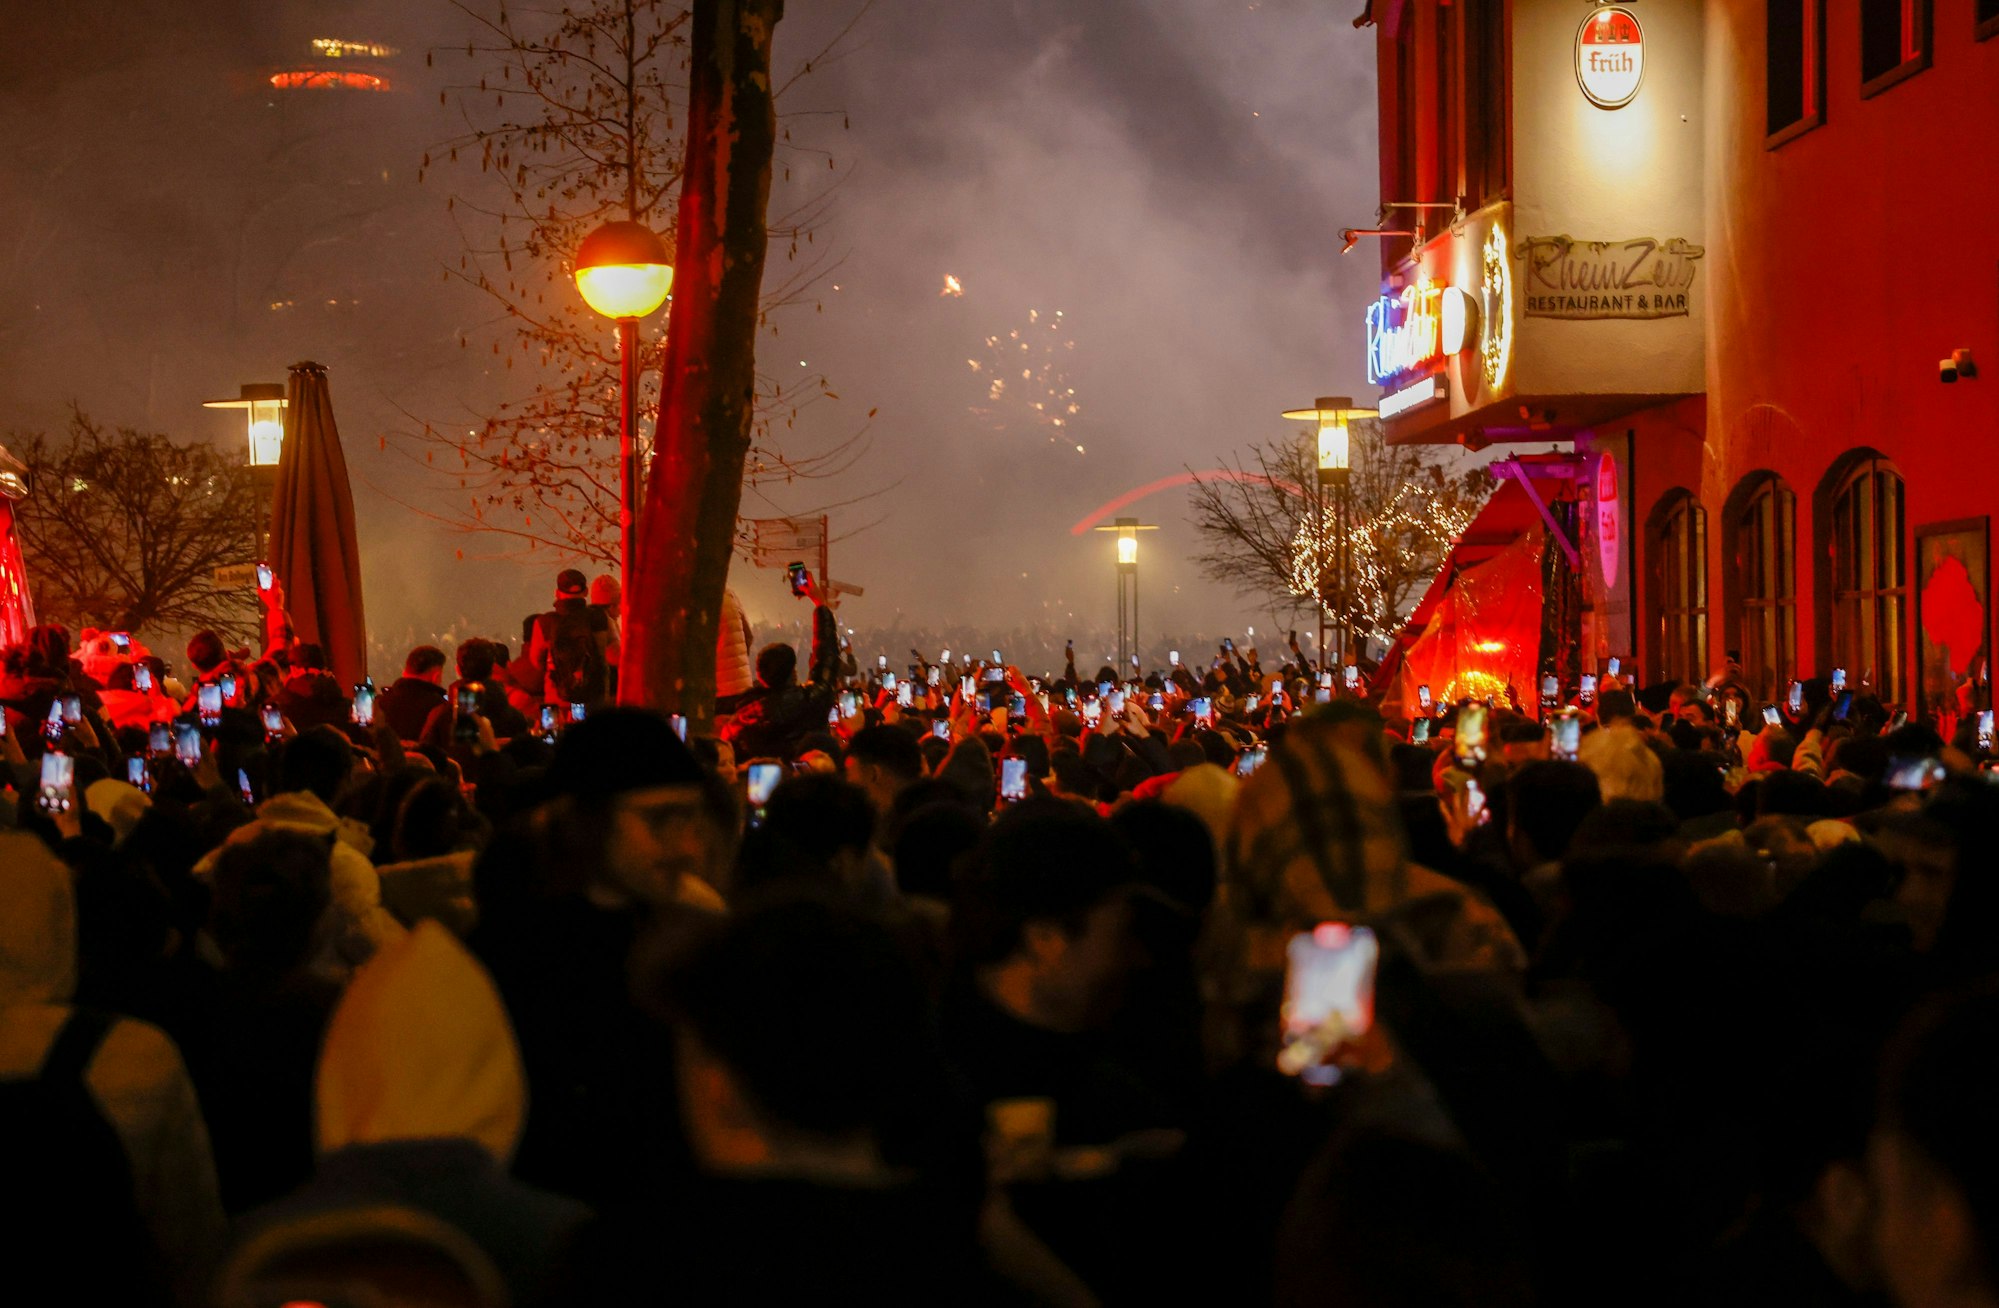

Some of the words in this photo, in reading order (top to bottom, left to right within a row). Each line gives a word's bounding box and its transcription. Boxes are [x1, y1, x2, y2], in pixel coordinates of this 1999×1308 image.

[1588, 50, 1633, 73] früh
[1527, 294, 1633, 310] RESTAURANT
[1637, 294, 1649, 309] &
[1653, 293, 1686, 309] BAR
